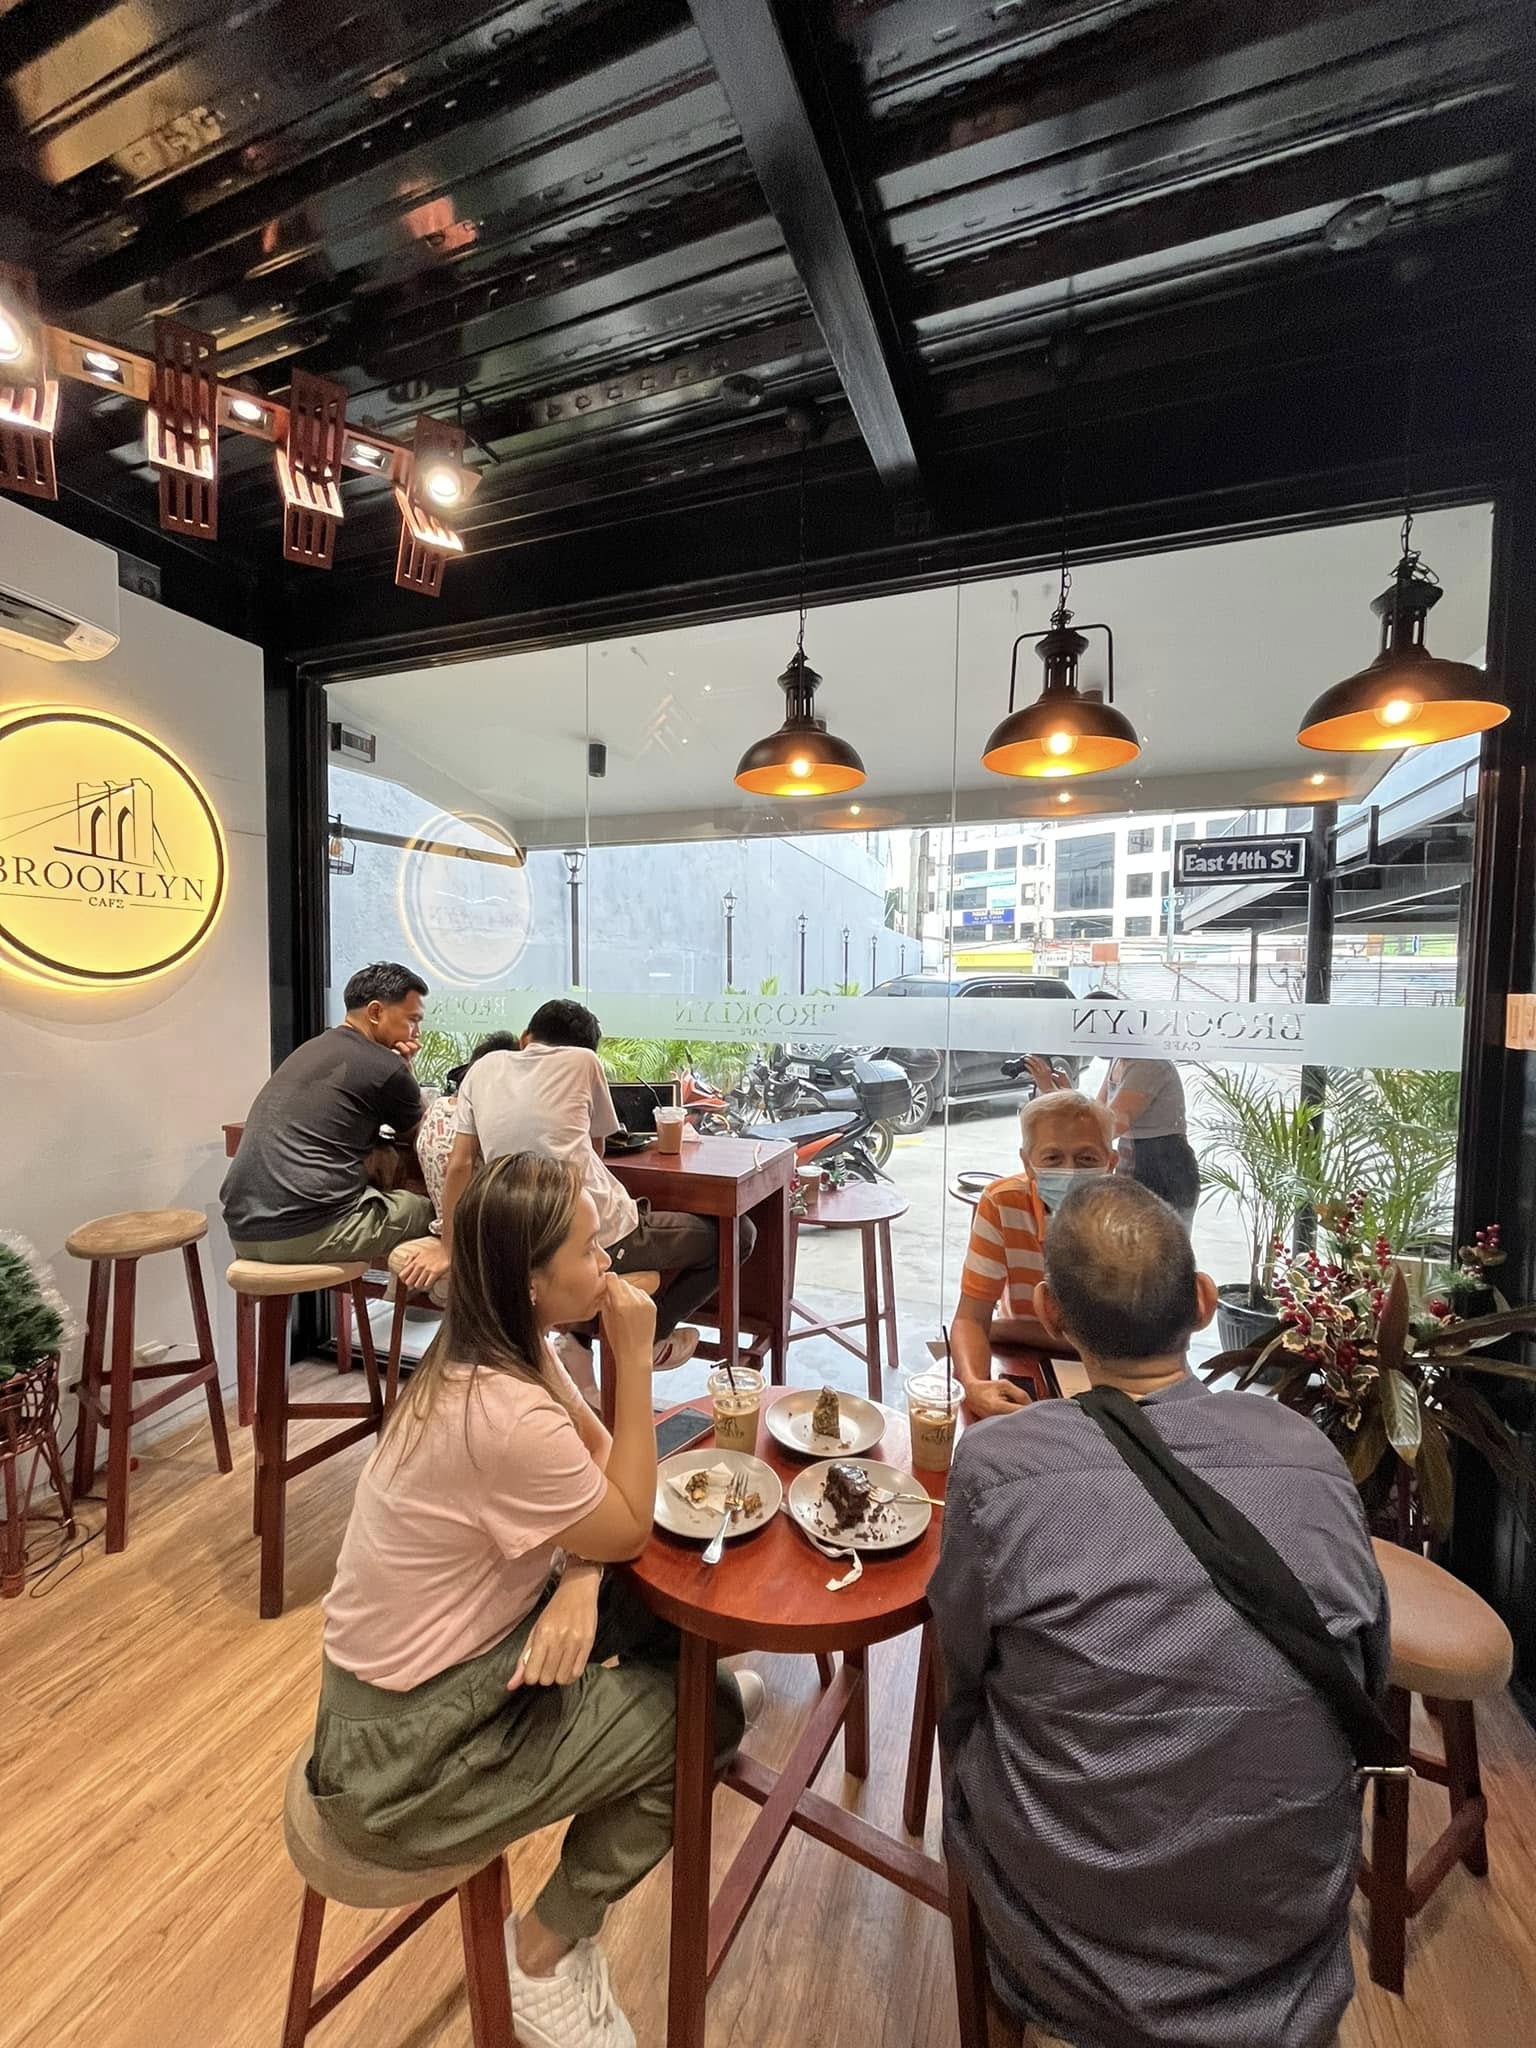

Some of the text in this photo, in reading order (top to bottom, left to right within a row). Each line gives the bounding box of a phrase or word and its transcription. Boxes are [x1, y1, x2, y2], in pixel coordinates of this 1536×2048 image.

[1185, 849, 1294, 872] East 44th St
